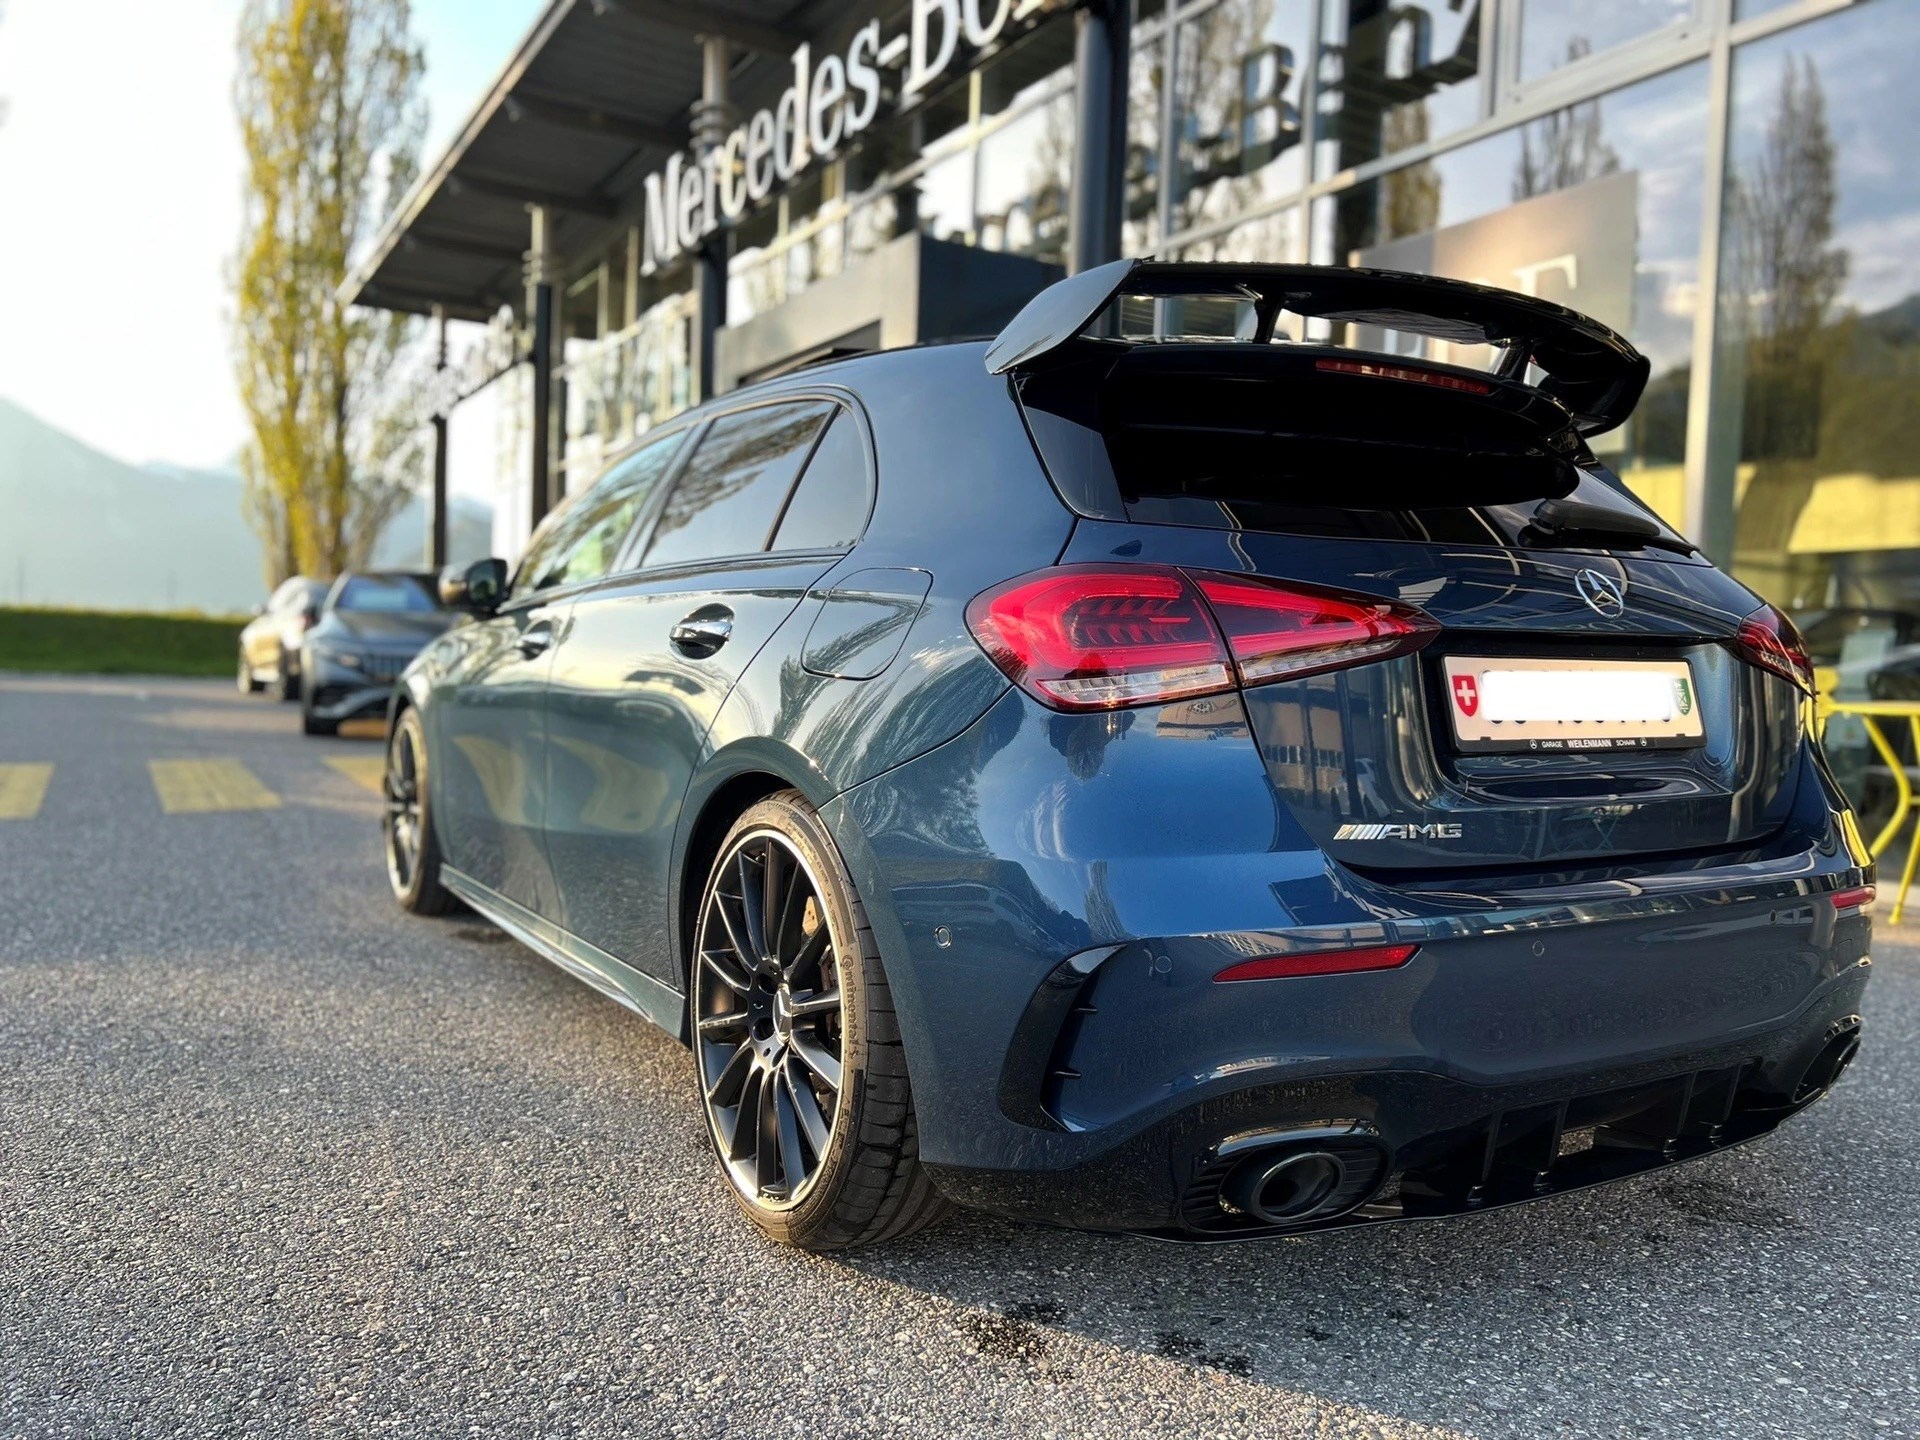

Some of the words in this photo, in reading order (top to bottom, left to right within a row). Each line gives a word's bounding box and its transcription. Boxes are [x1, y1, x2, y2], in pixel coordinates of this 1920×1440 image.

[641, 0, 1045, 276] Mercedes-B
[1541, 740, 1563, 748] GARAGE
[1566, 738, 1612, 749] WEILENMANN
[1377, 823, 1462, 840] AMG
